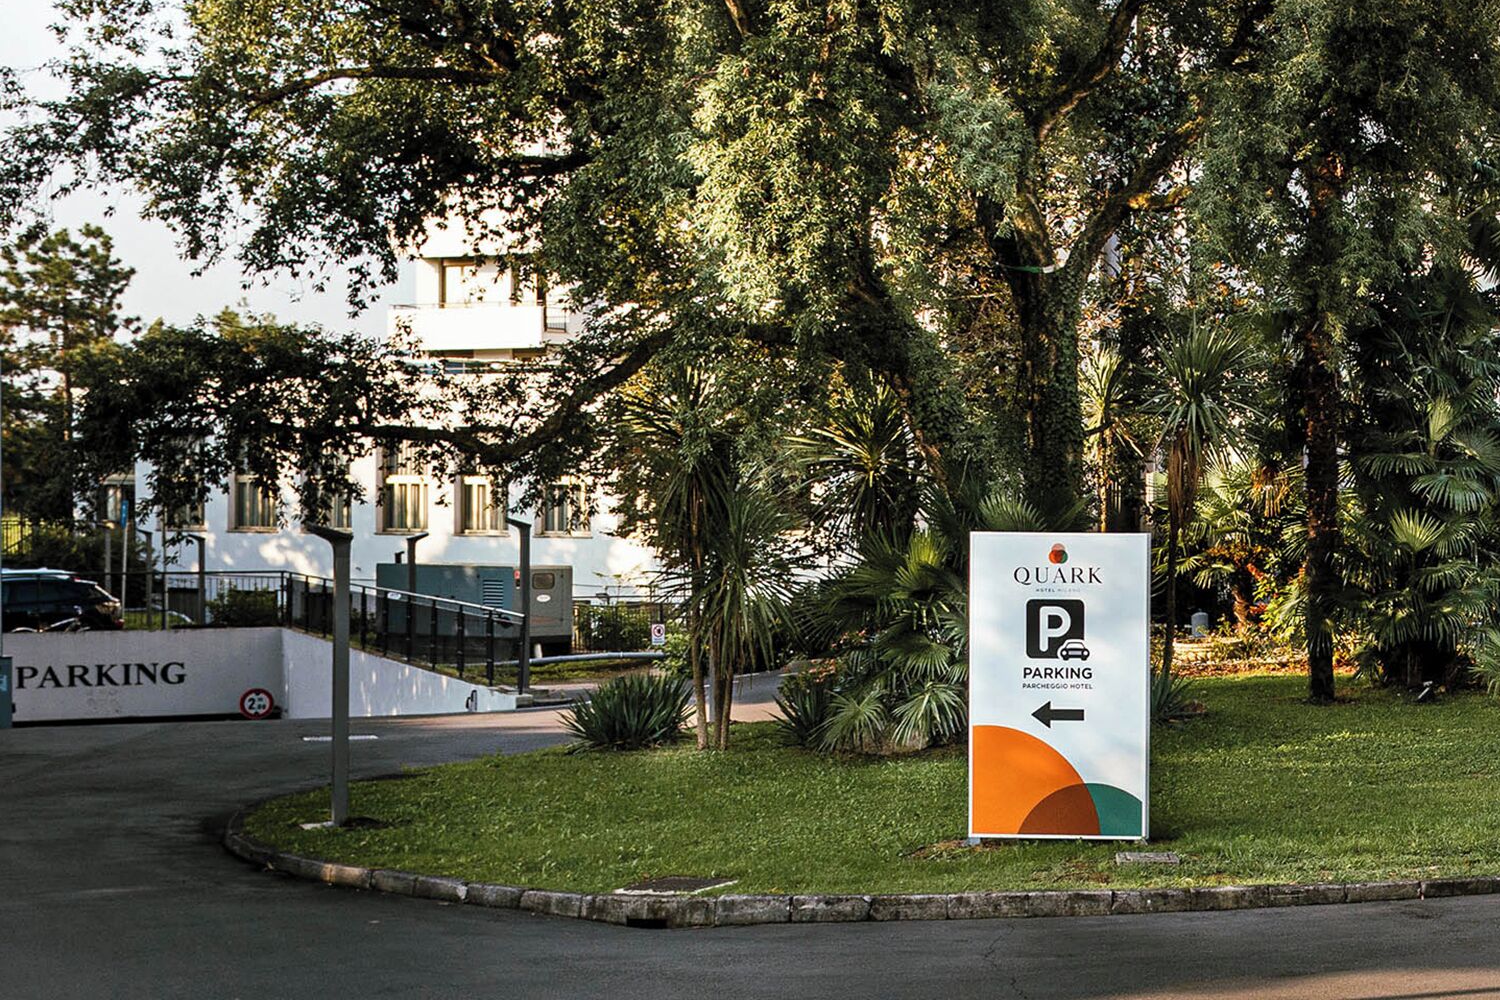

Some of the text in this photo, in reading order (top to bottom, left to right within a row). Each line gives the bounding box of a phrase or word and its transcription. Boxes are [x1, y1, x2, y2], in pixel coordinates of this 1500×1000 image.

[1013, 566, 1103, 585] QUARK
[1040, 606, 1071, 651] P
[16, 662, 187, 689] PARKING
[1023, 667, 1093, 679] PARKING
